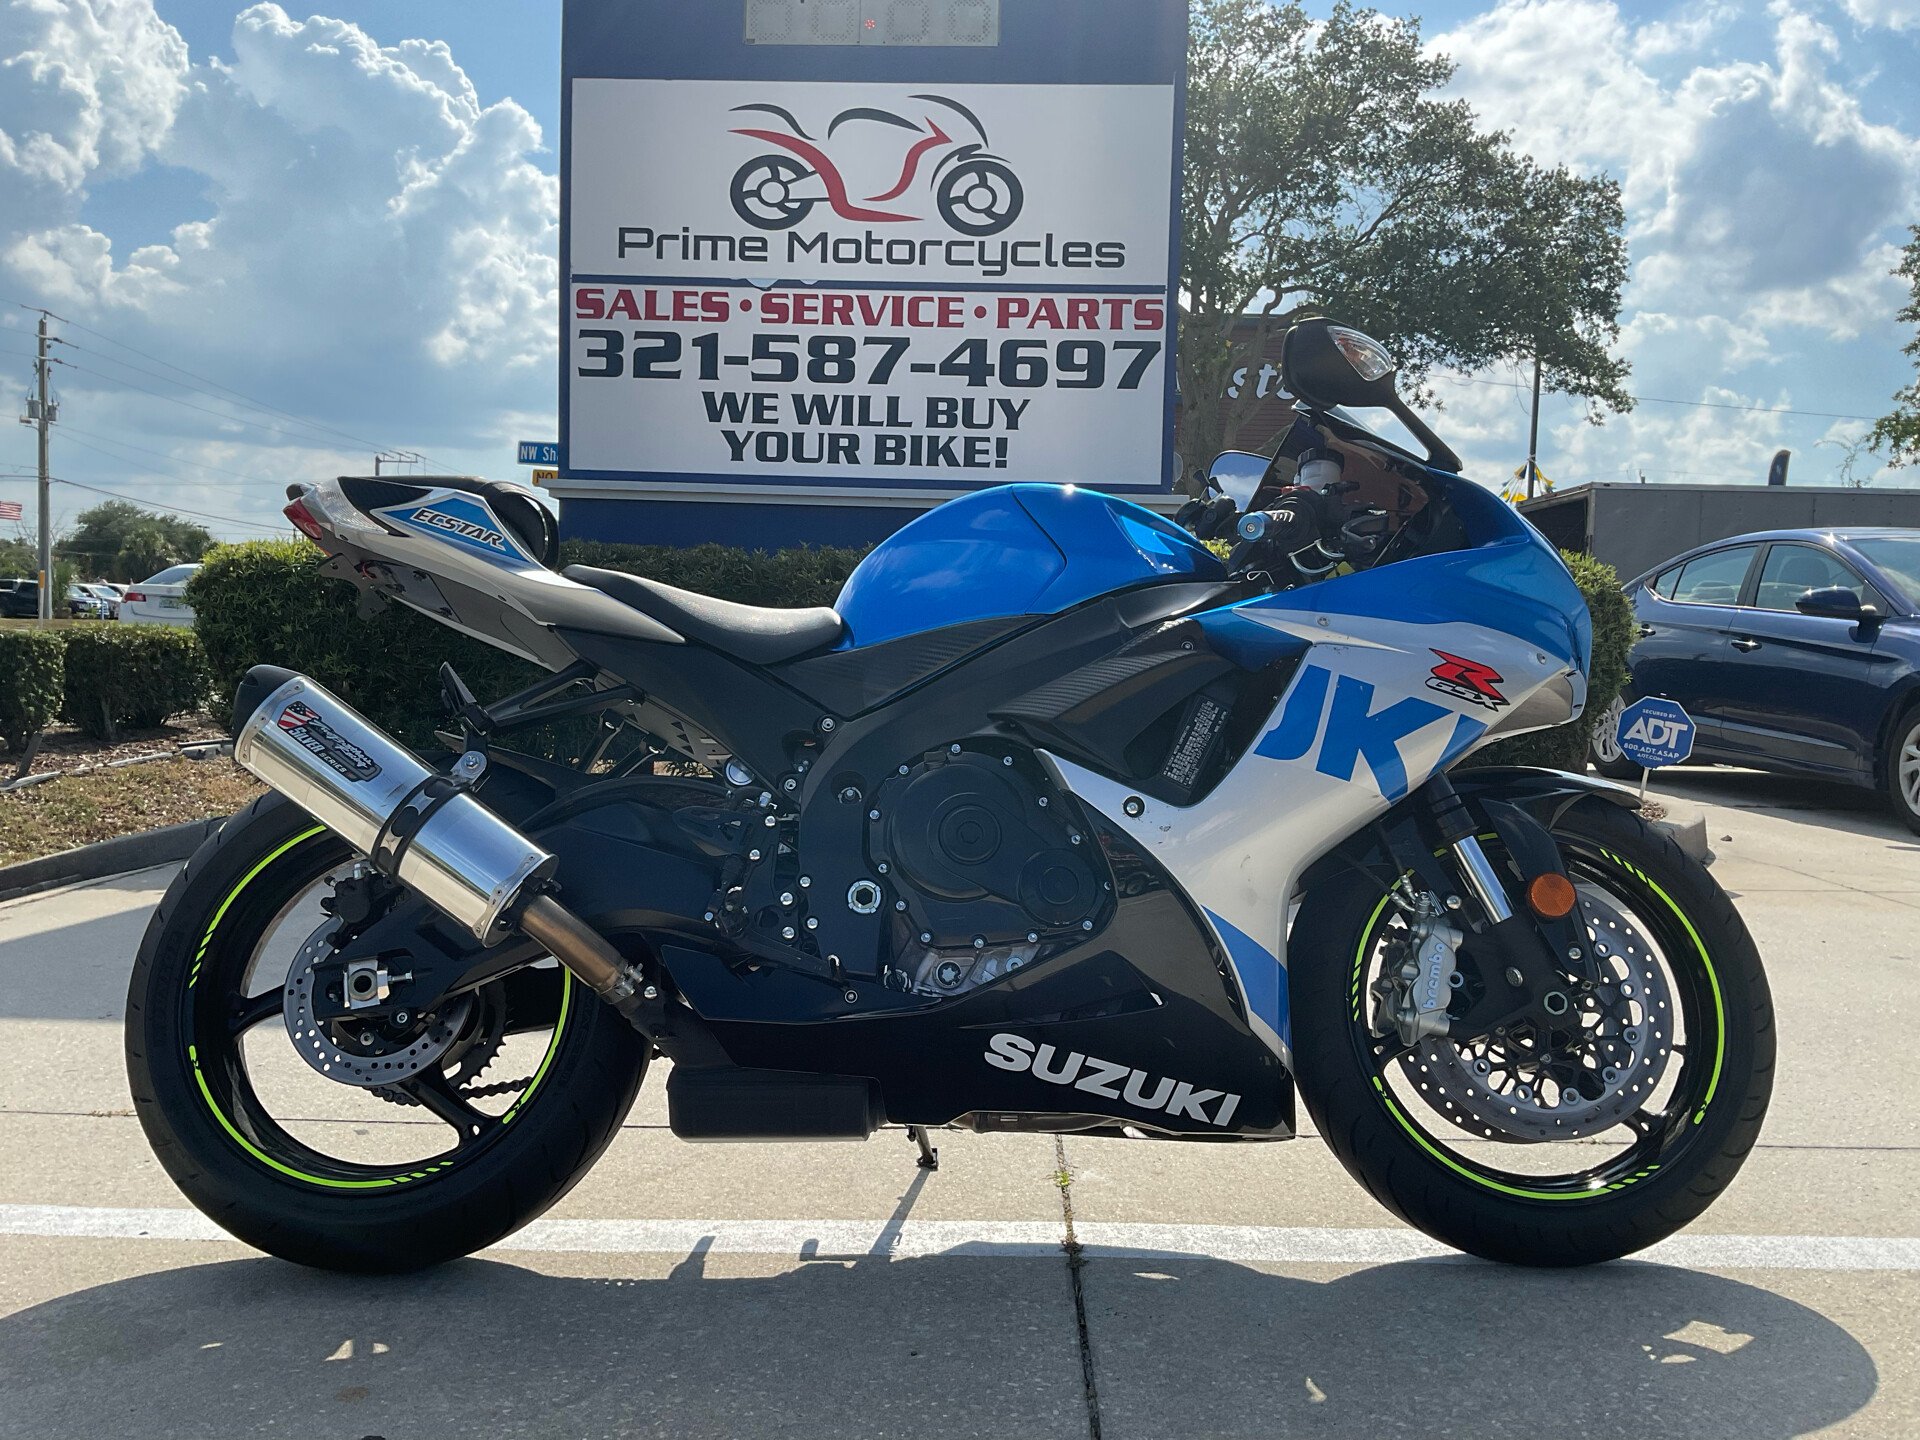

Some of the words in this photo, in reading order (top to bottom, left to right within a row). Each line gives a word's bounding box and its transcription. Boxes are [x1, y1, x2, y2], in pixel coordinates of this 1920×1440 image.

[617, 226, 769, 263] Prime
[787, 231, 1126, 276] Motorcycles
[576, 288, 731, 323] SALES
[760, 293, 965, 328] SERVICE
[997, 298, 1165, 331] PARTS
[577, 330, 1162, 390] 321-587-4697
[701, 391, 779, 425] WE
[791, 395, 913, 428] WILL
[925, 398, 1031, 431] BUY
[520, 445, 538, 460] NW
[542, 446, 559, 462] Sh
[721, 430, 861, 465] YOUR
[873, 435, 1009, 469] BIKE!
[411, 508, 506, 551] ECSTAR
[1424, 676, 1499, 712] GSX
[1642, 708, 1667, 718] SECURED
[1623, 716, 1689, 749] ADT
[1422, 943, 1445, 1010] brembo
[984, 1033, 1242, 1127] SUZUKI
